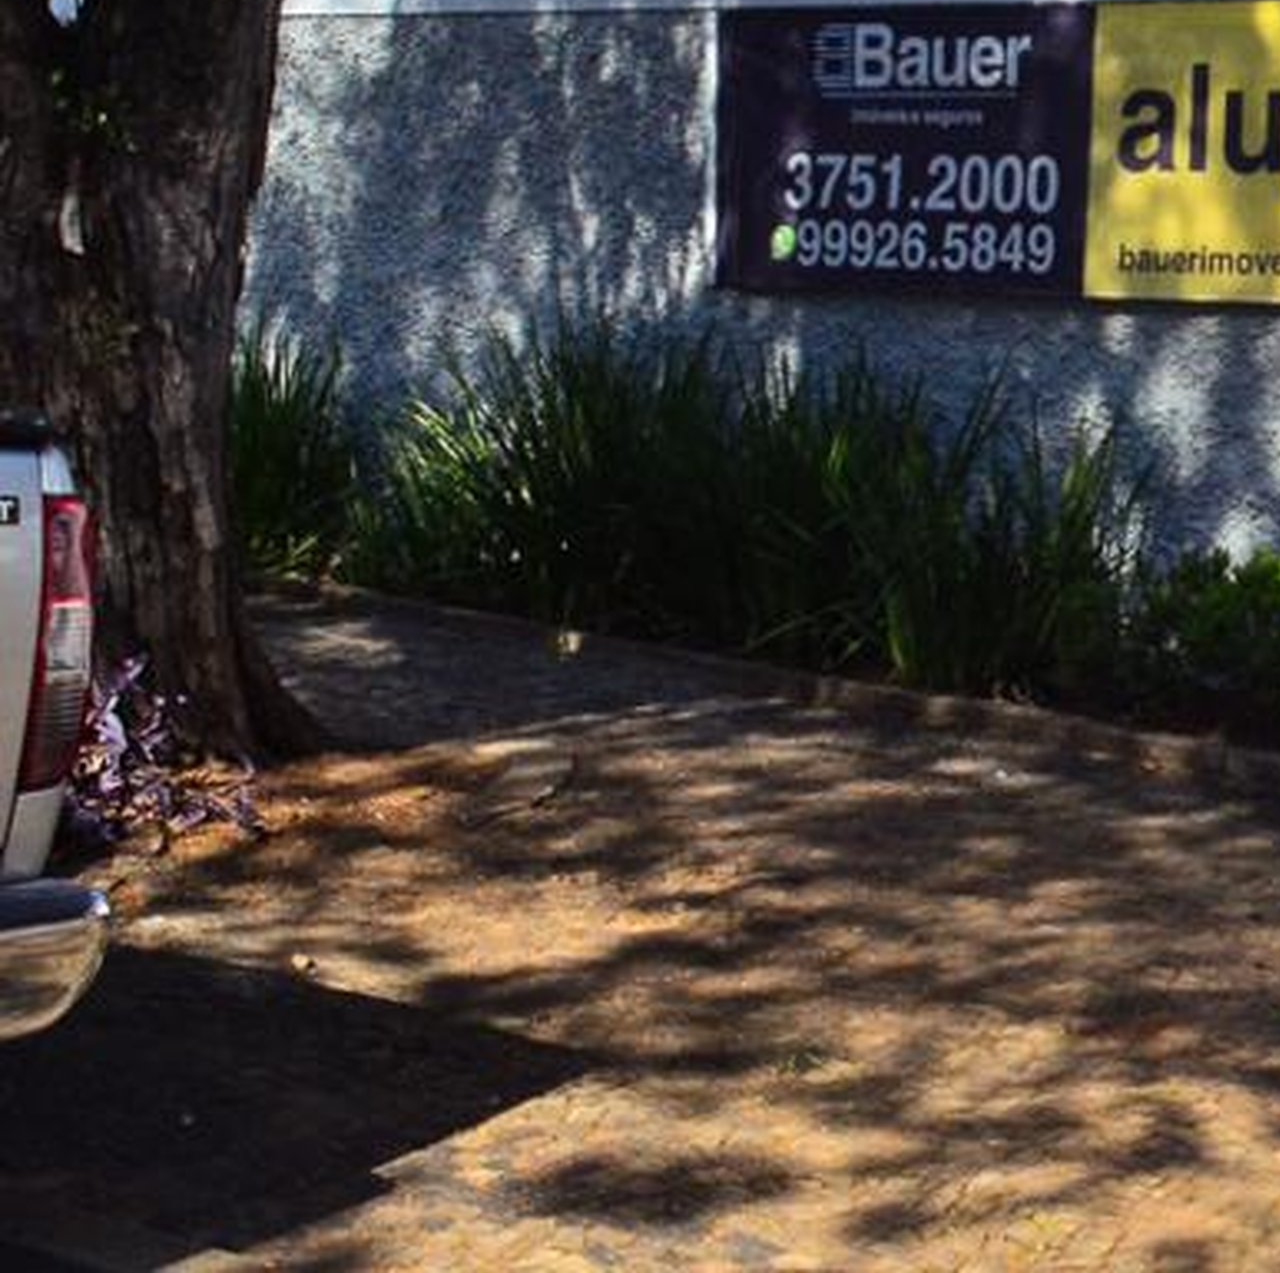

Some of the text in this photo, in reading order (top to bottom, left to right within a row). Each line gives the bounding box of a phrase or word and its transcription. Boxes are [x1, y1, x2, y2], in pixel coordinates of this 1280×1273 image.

[854, 23, 1033, 89] Bauer
[783, 152, 1060, 213] 3751.2000
[796, 220, 1056, 274] 99926.5849
